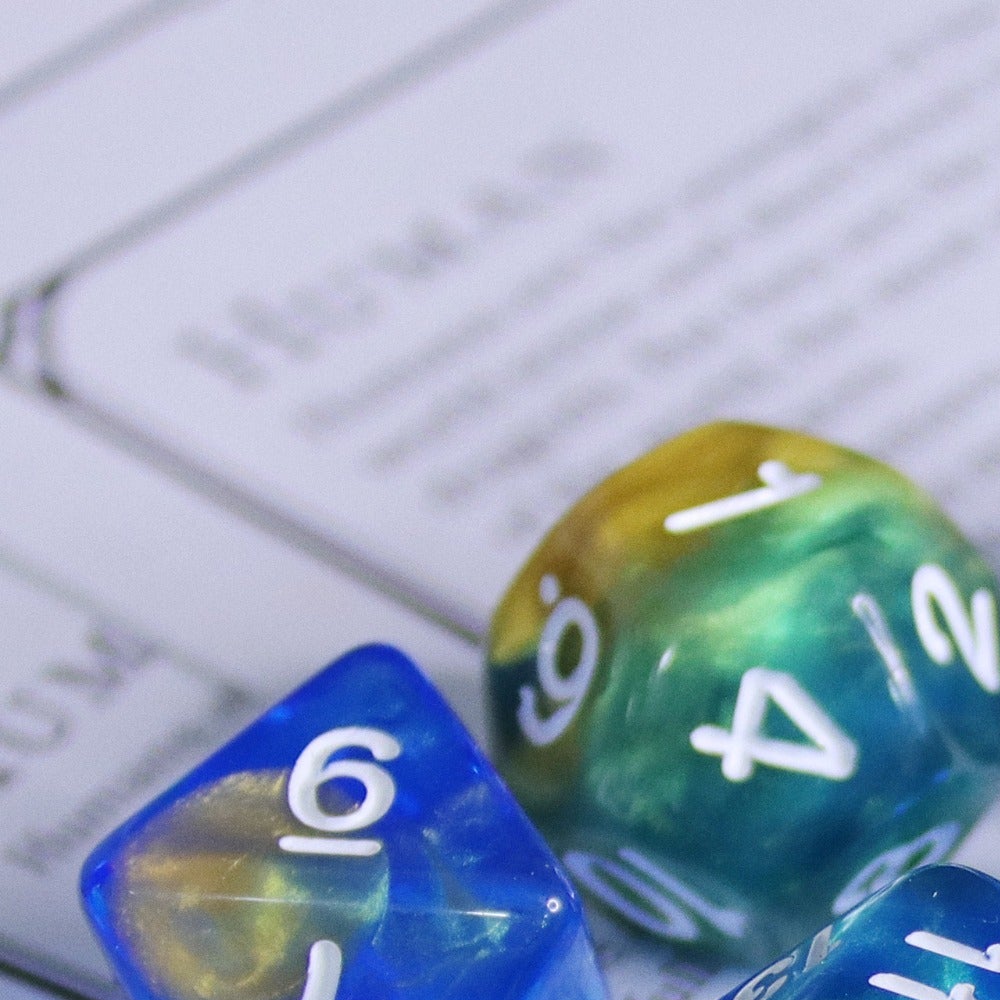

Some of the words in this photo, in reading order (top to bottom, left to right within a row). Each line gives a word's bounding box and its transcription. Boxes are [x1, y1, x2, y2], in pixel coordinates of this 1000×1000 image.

[665, 459, 822, 533] 1
[690, 666, 858, 783] 4
[279, 726, 402, 857] 6
